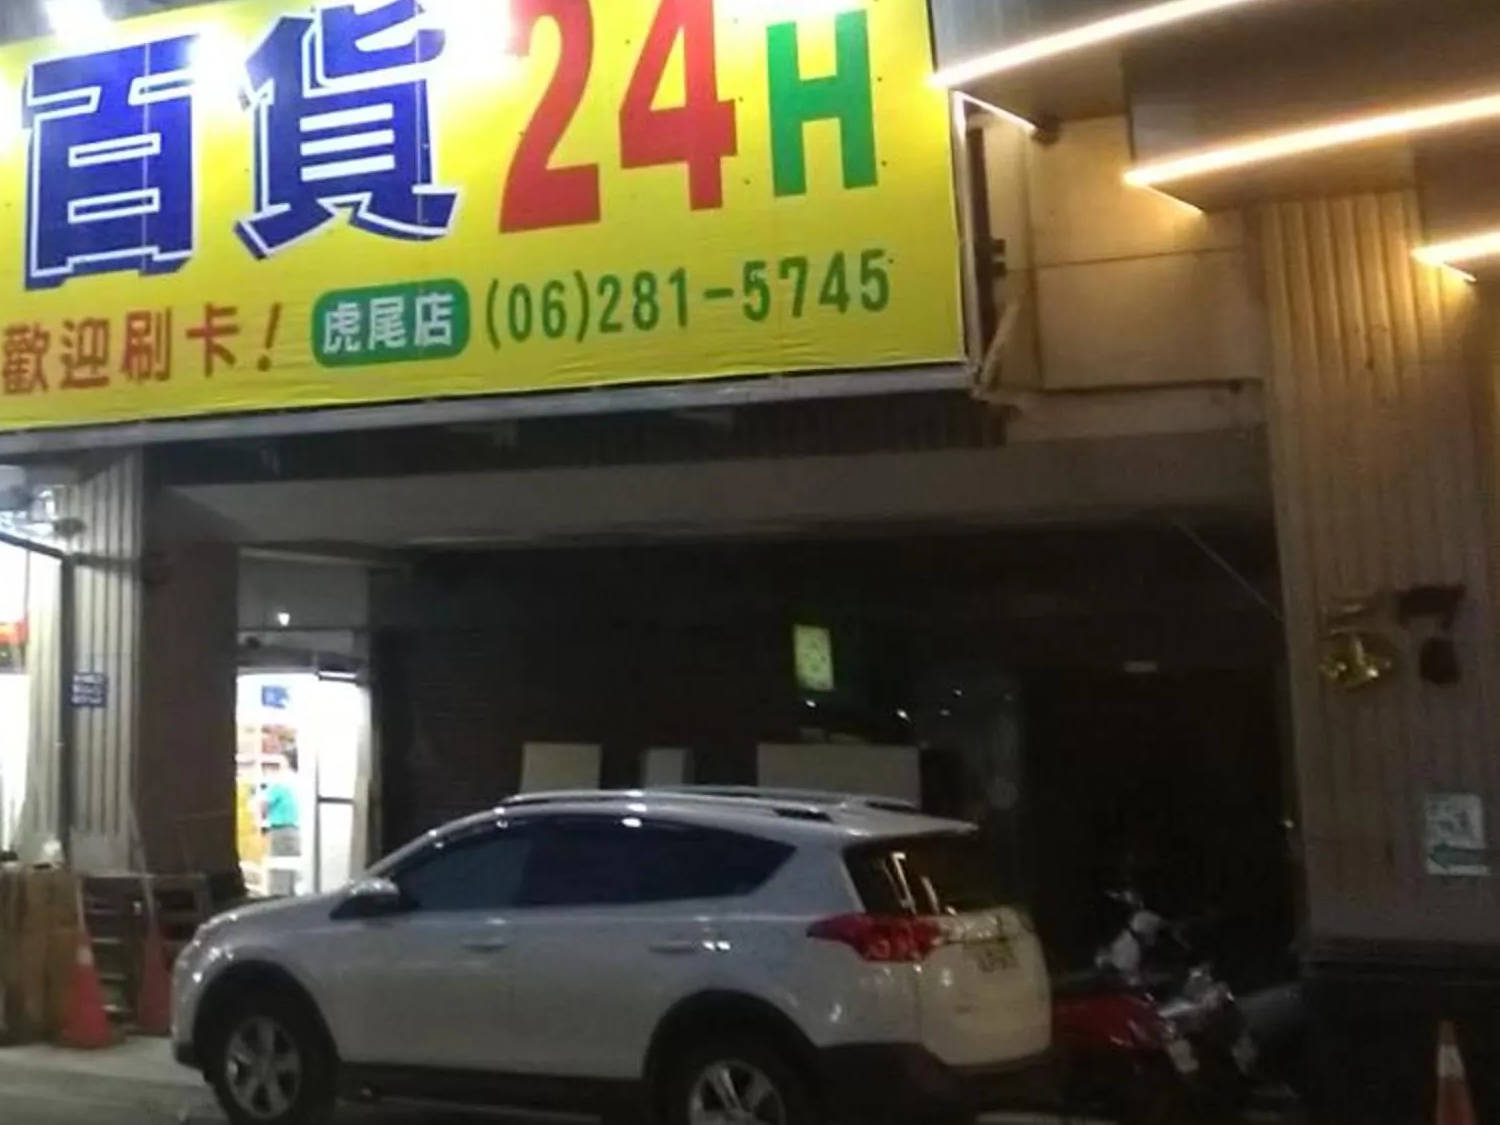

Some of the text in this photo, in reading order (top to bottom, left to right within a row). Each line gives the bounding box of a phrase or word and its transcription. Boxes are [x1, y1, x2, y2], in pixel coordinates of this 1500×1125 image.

[322, 290, 456, 355] 虎尾店
[485, 248, 891, 351] (06)281-5745
